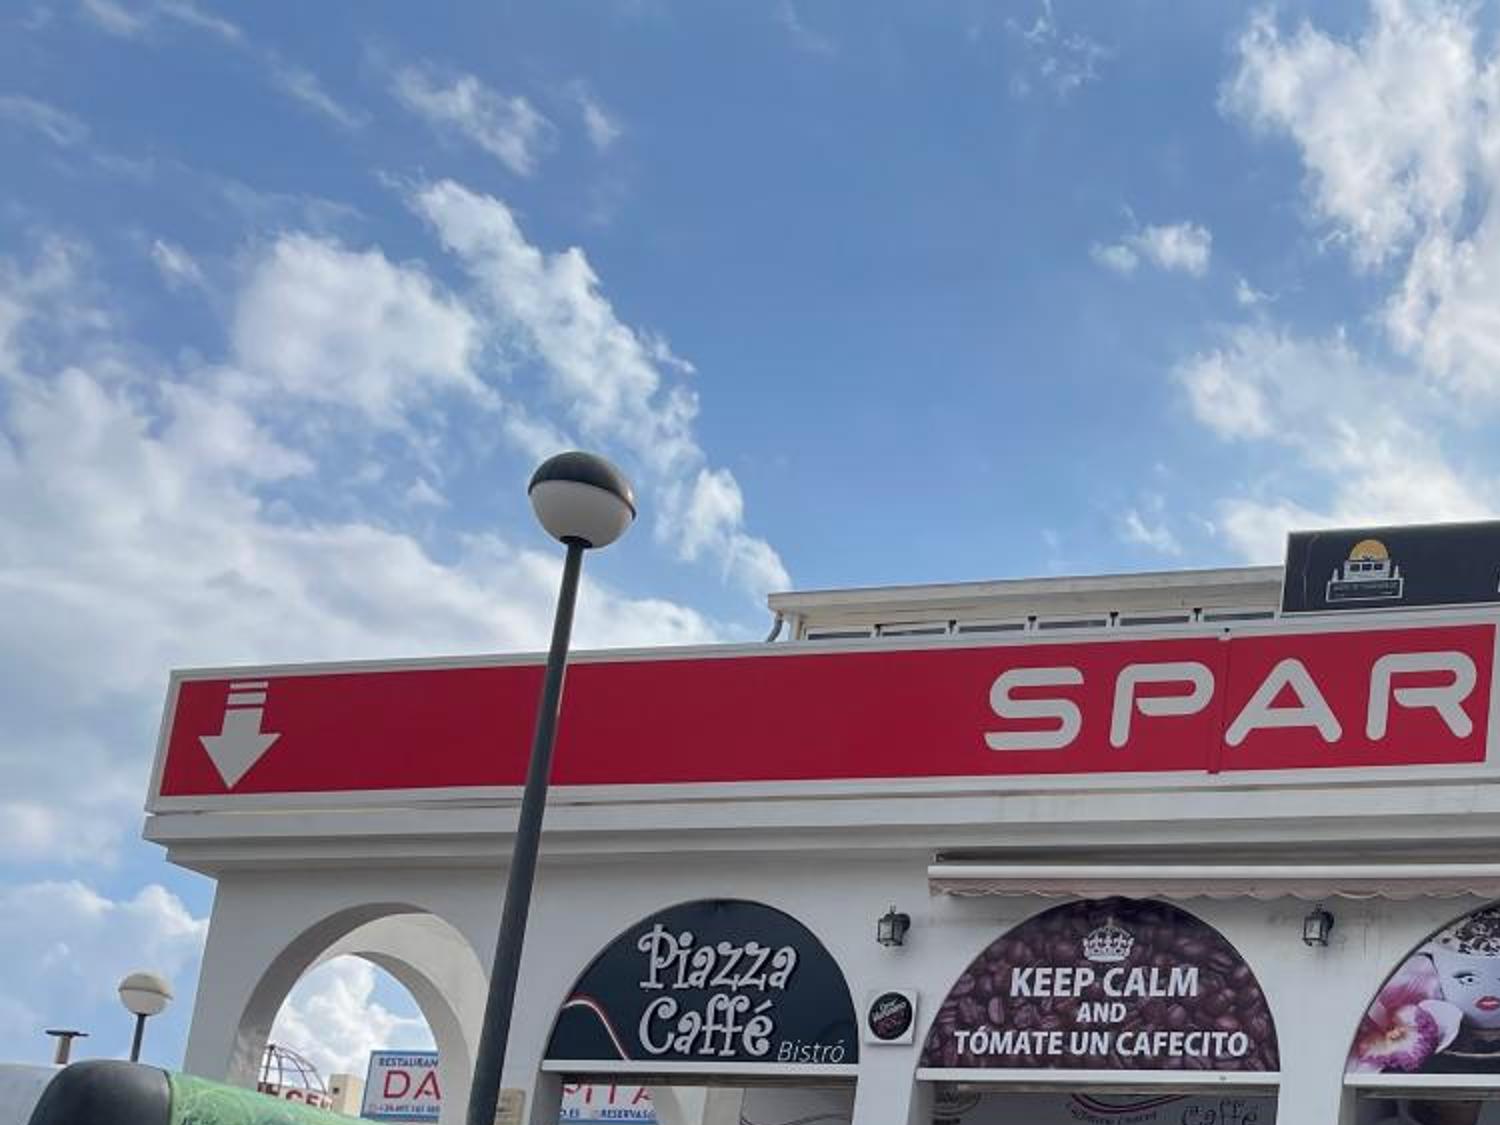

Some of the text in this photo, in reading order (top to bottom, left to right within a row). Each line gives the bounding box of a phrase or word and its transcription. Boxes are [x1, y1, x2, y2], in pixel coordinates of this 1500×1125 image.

[984, 651, 1477, 751] SPAR
[638, 924, 797, 990] Piazza
[1010, 967, 1198, 997] KEEP CALM
[638, 993, 773, 1056] Caffé
[1076, 1002, 1126, 1023] AND
[777, 1040, 844, 1063] Bistró
[954, 1026, 1249, 1057] TÓMATE UN CAFECITO
